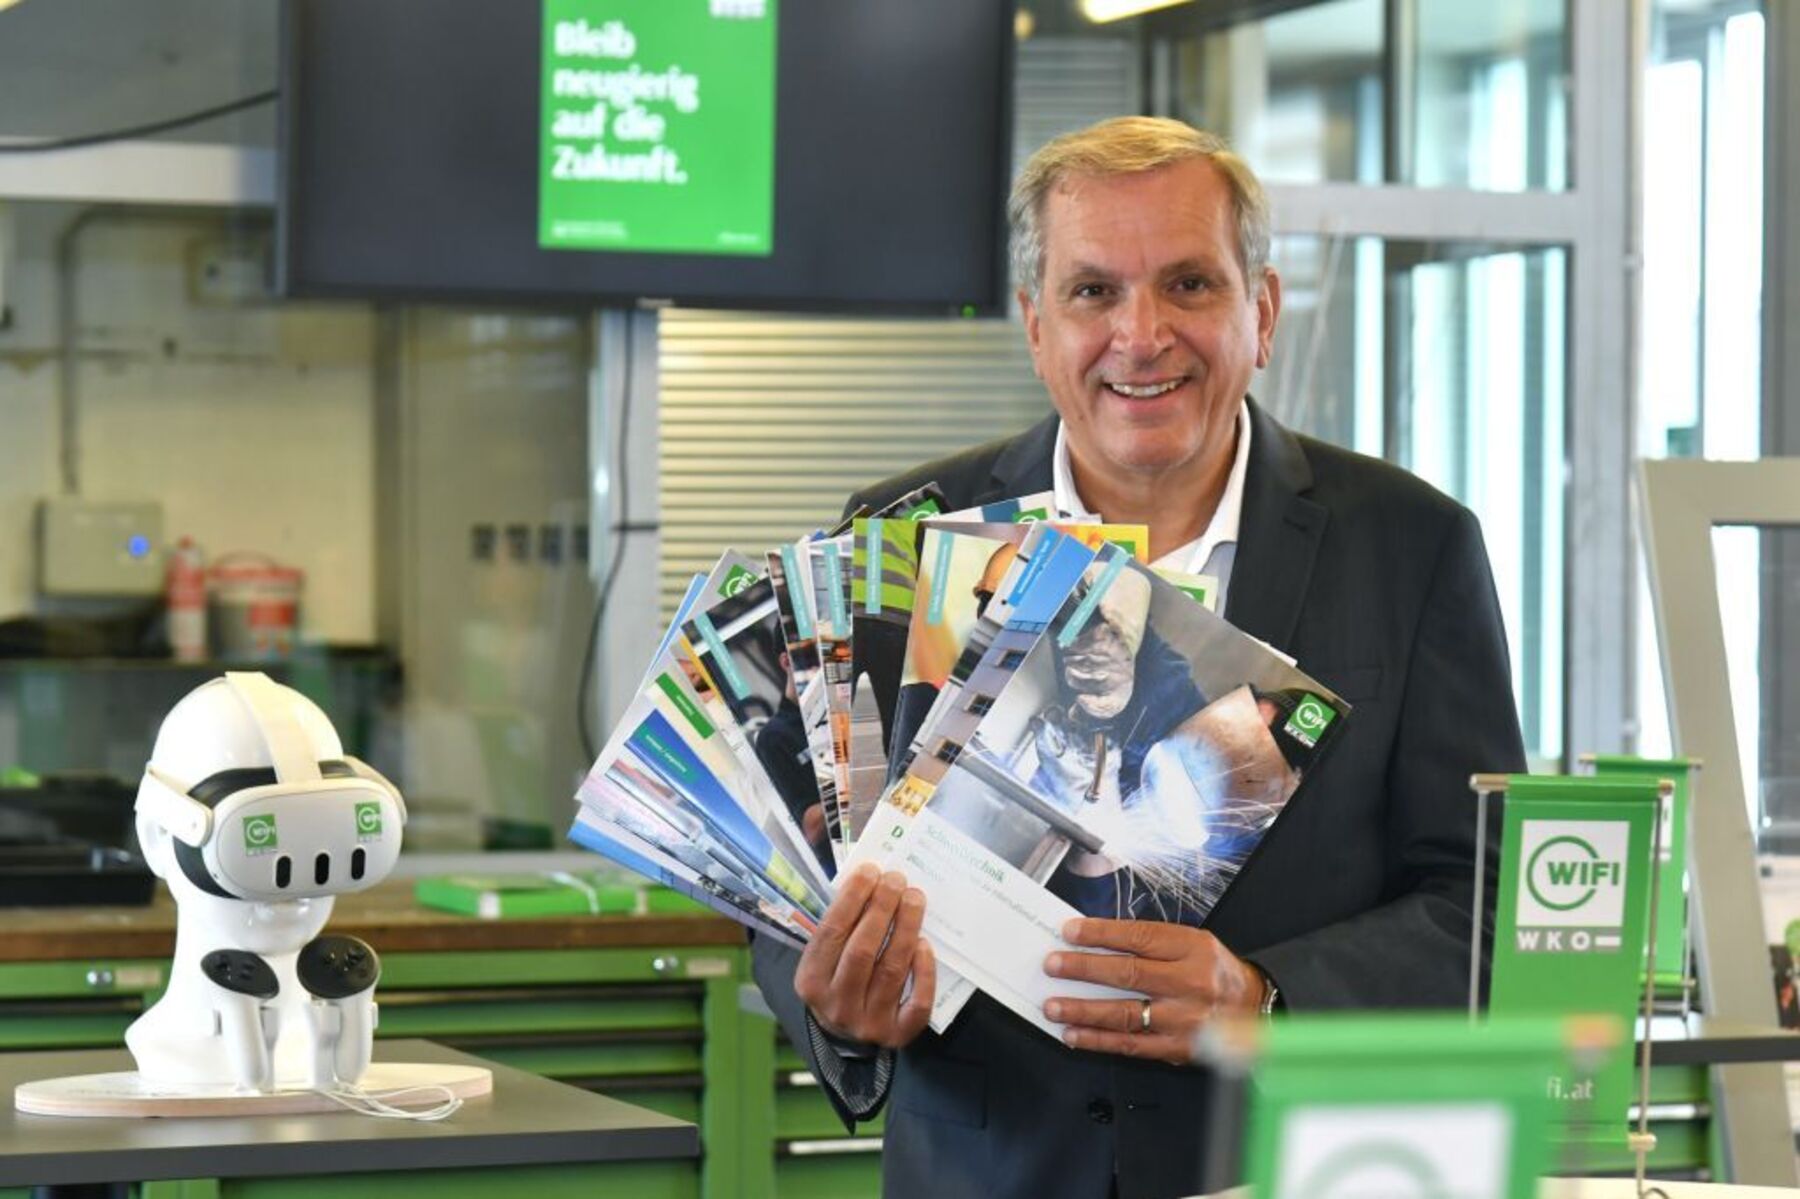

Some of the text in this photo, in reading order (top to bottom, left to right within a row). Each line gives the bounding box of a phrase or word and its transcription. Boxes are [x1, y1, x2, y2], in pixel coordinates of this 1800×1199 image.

[555, 20, 636, 58] Bleib
[553, 64, 699, 112] neugierig
[552, 103, 665, 140] auf die
[551, 144, 688, 183] Zukunft.
[1547, 861, 1620, 886] WIFI
[1517, 930, 1590, 951] WKO
[1547, 1076, 1593, 1100] fi.at
